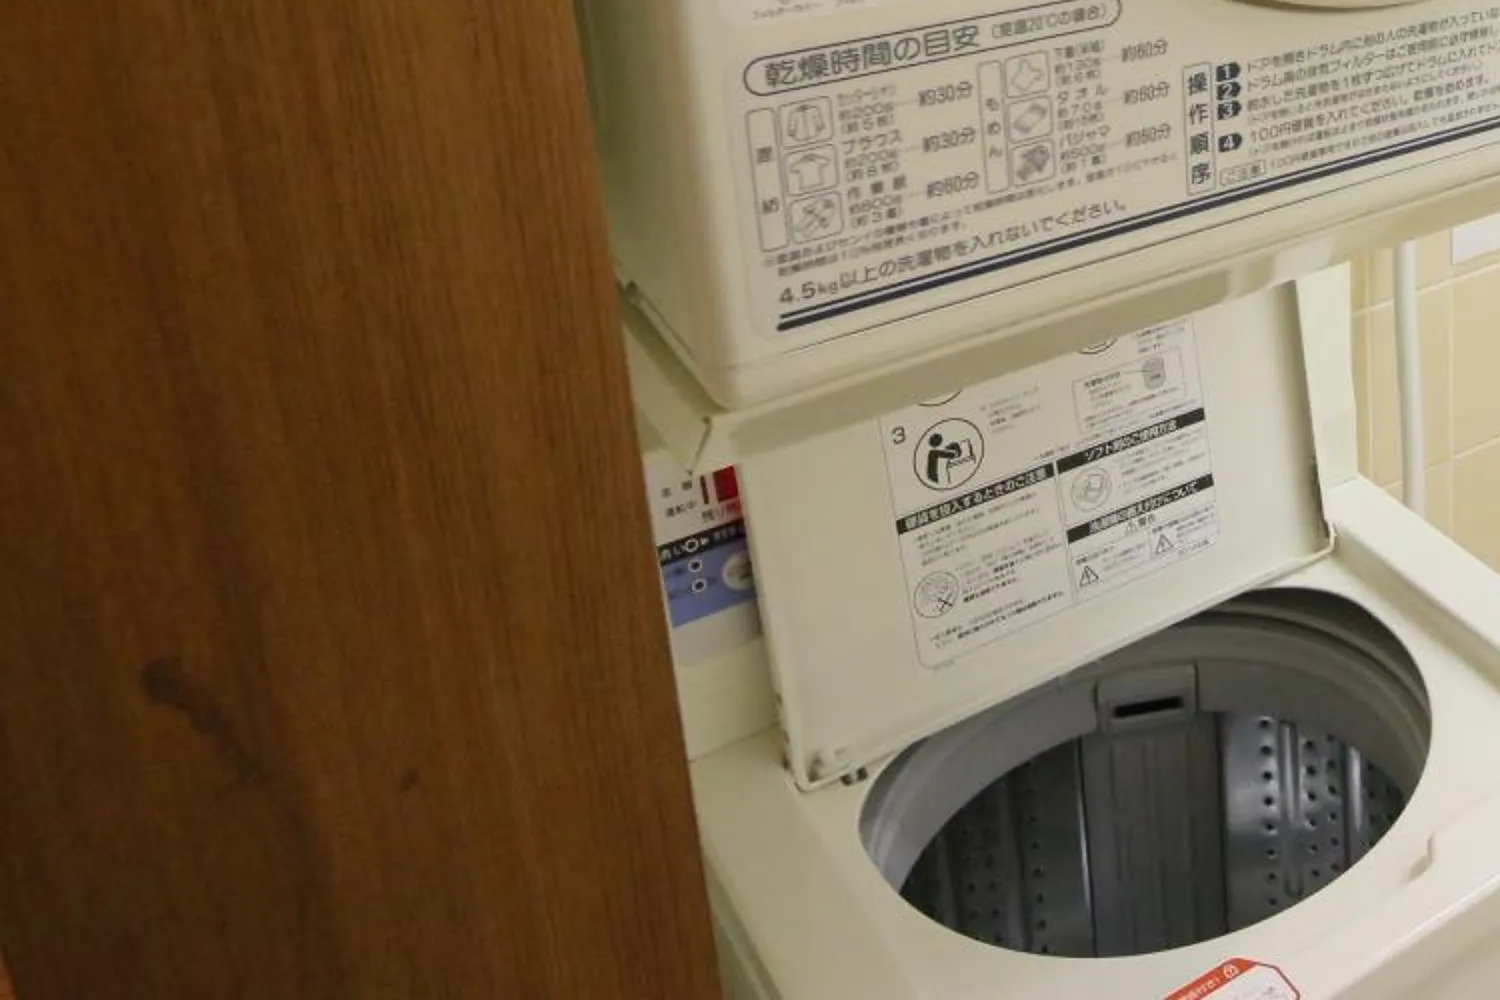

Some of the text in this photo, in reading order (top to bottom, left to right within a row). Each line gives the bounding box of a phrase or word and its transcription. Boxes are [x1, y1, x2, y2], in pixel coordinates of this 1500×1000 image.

[764, 25, 980, 88] 乾燥時間の目安
[918, 81, 974, 107] 約30分
[1187, 71, 1212, 185] 操作順序
[890, 425, 907, 446] 3
